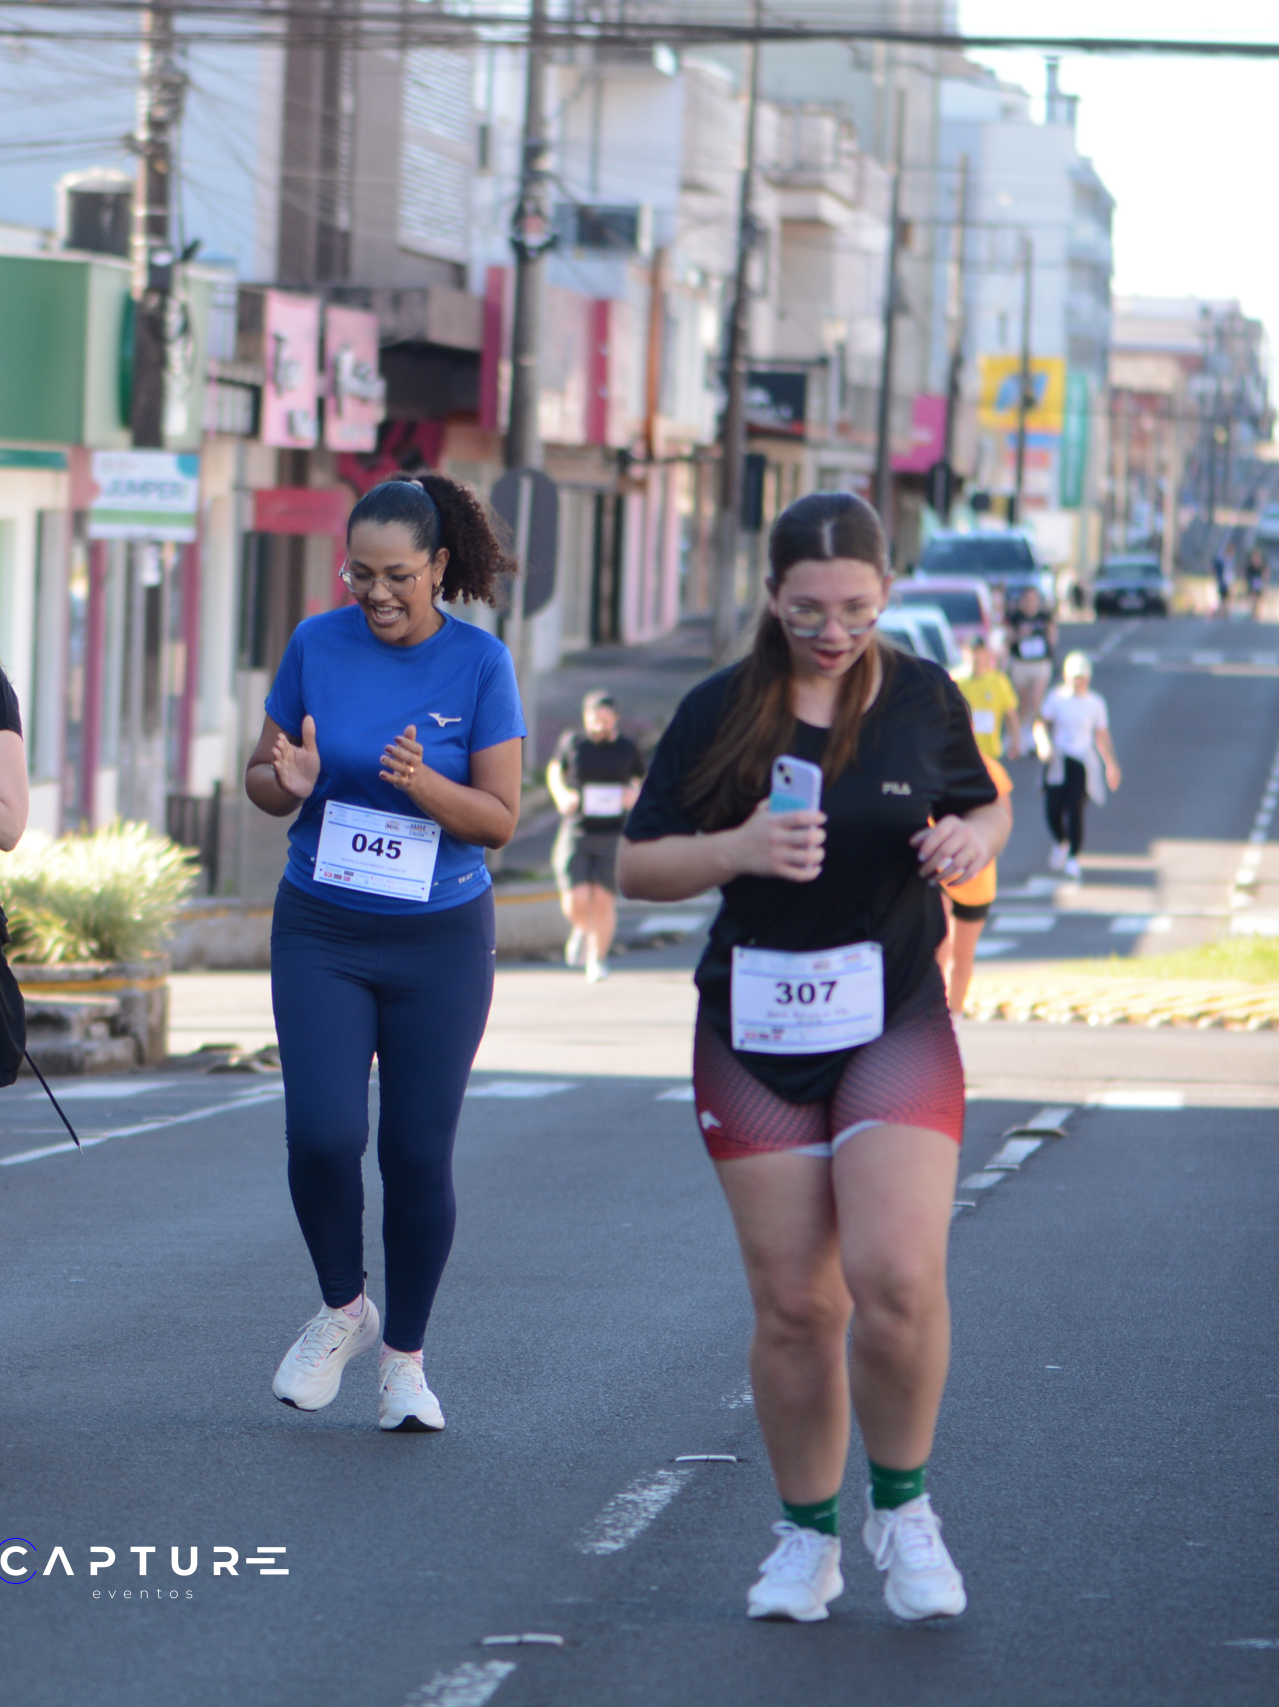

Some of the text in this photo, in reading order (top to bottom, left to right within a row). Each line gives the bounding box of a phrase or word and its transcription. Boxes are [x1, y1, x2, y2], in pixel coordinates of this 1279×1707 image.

[882, 782, 911, 795] FILA
[351, 833, 403, 860] 045
[775, 980, 839, 1005] 307
